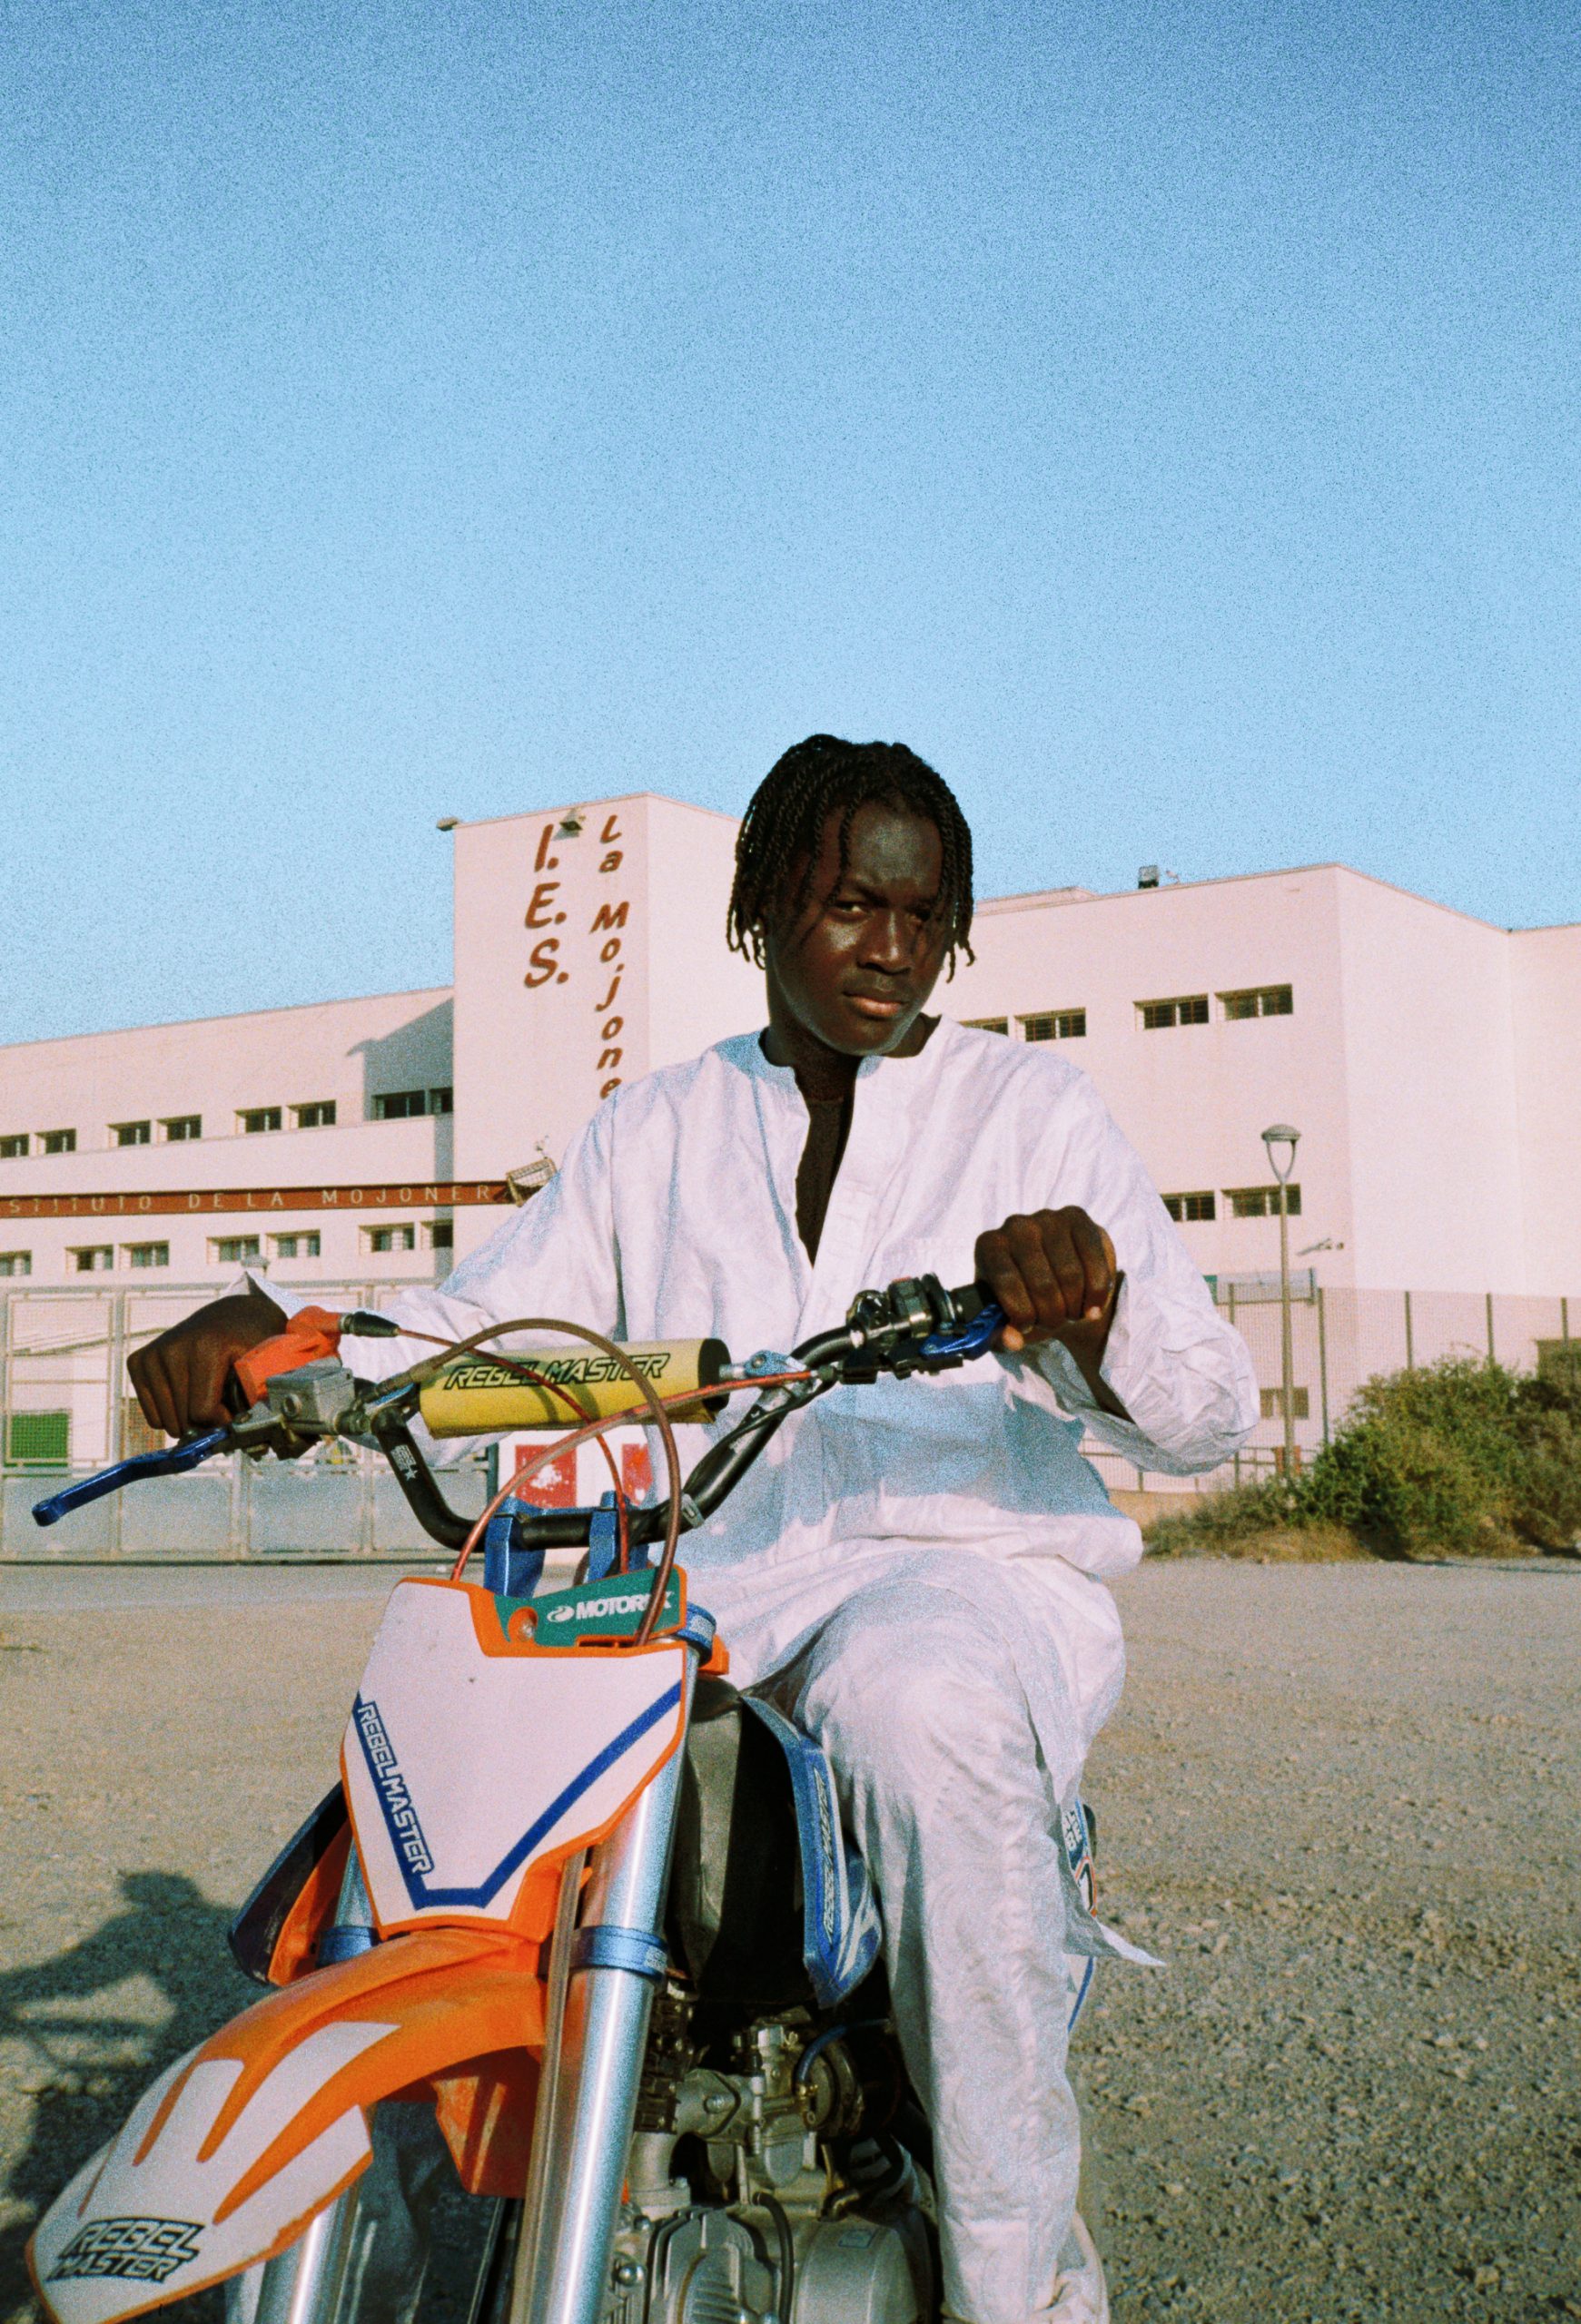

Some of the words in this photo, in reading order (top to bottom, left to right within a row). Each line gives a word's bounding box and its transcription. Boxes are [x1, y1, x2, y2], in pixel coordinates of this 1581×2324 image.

[188, 1192, 224, 1209] DE
[246, 1190, 284, 1207] LA
[321, 1184, 490, 1206] MOJONER
[544, 1353, 670, 1385] MASTER
[358, 1701, 398, 1778] REBEL
[381, 1774, 435, 1874] MASTER
[59, 2217, 205, 2261] REBEL
